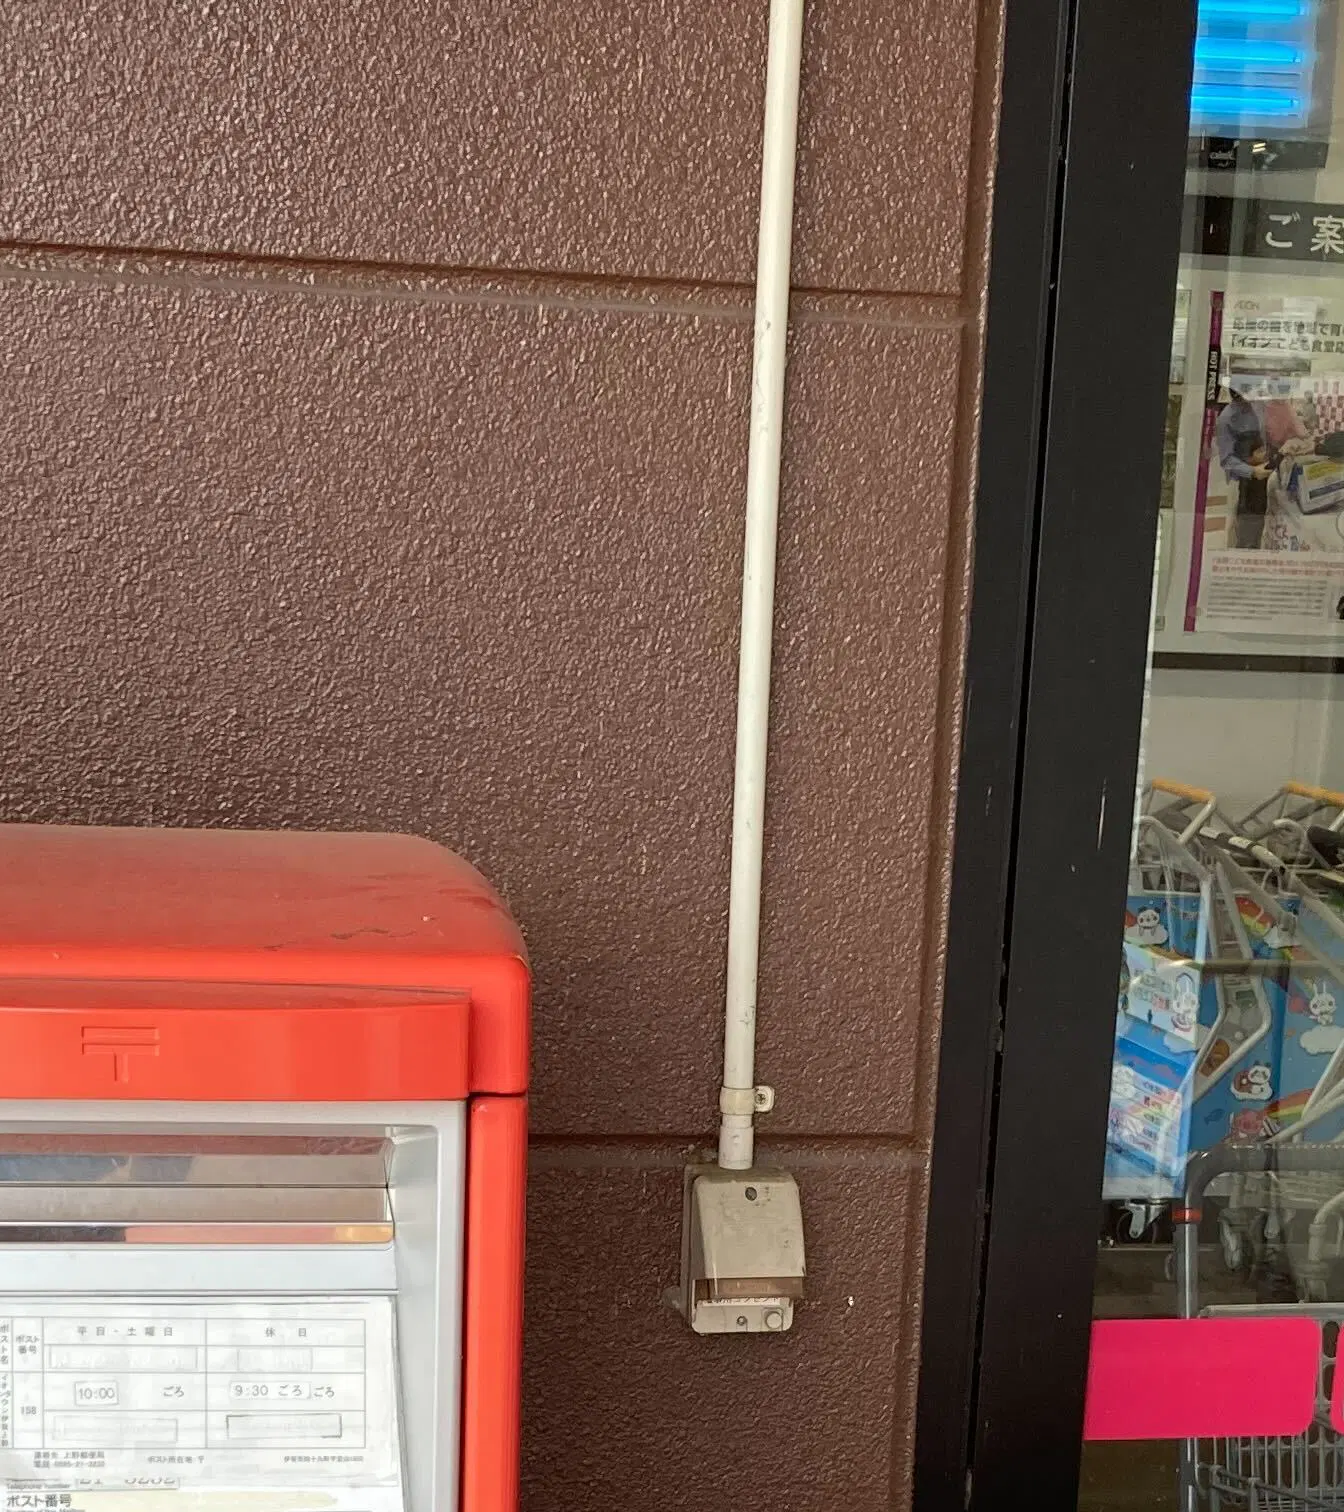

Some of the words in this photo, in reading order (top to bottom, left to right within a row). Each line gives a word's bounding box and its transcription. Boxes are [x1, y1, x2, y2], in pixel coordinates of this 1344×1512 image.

[78, 1387, 115, 1400] 10:00
[163, 1385, 185, 1398] ごろ
[234, 1384, 269, 1397] 9:30
[278, 1384, 303, 1397] ごろ
[313, 1386, 335, 1398] ごろ
[7, 1493, 72, 1508] ポスト番号
